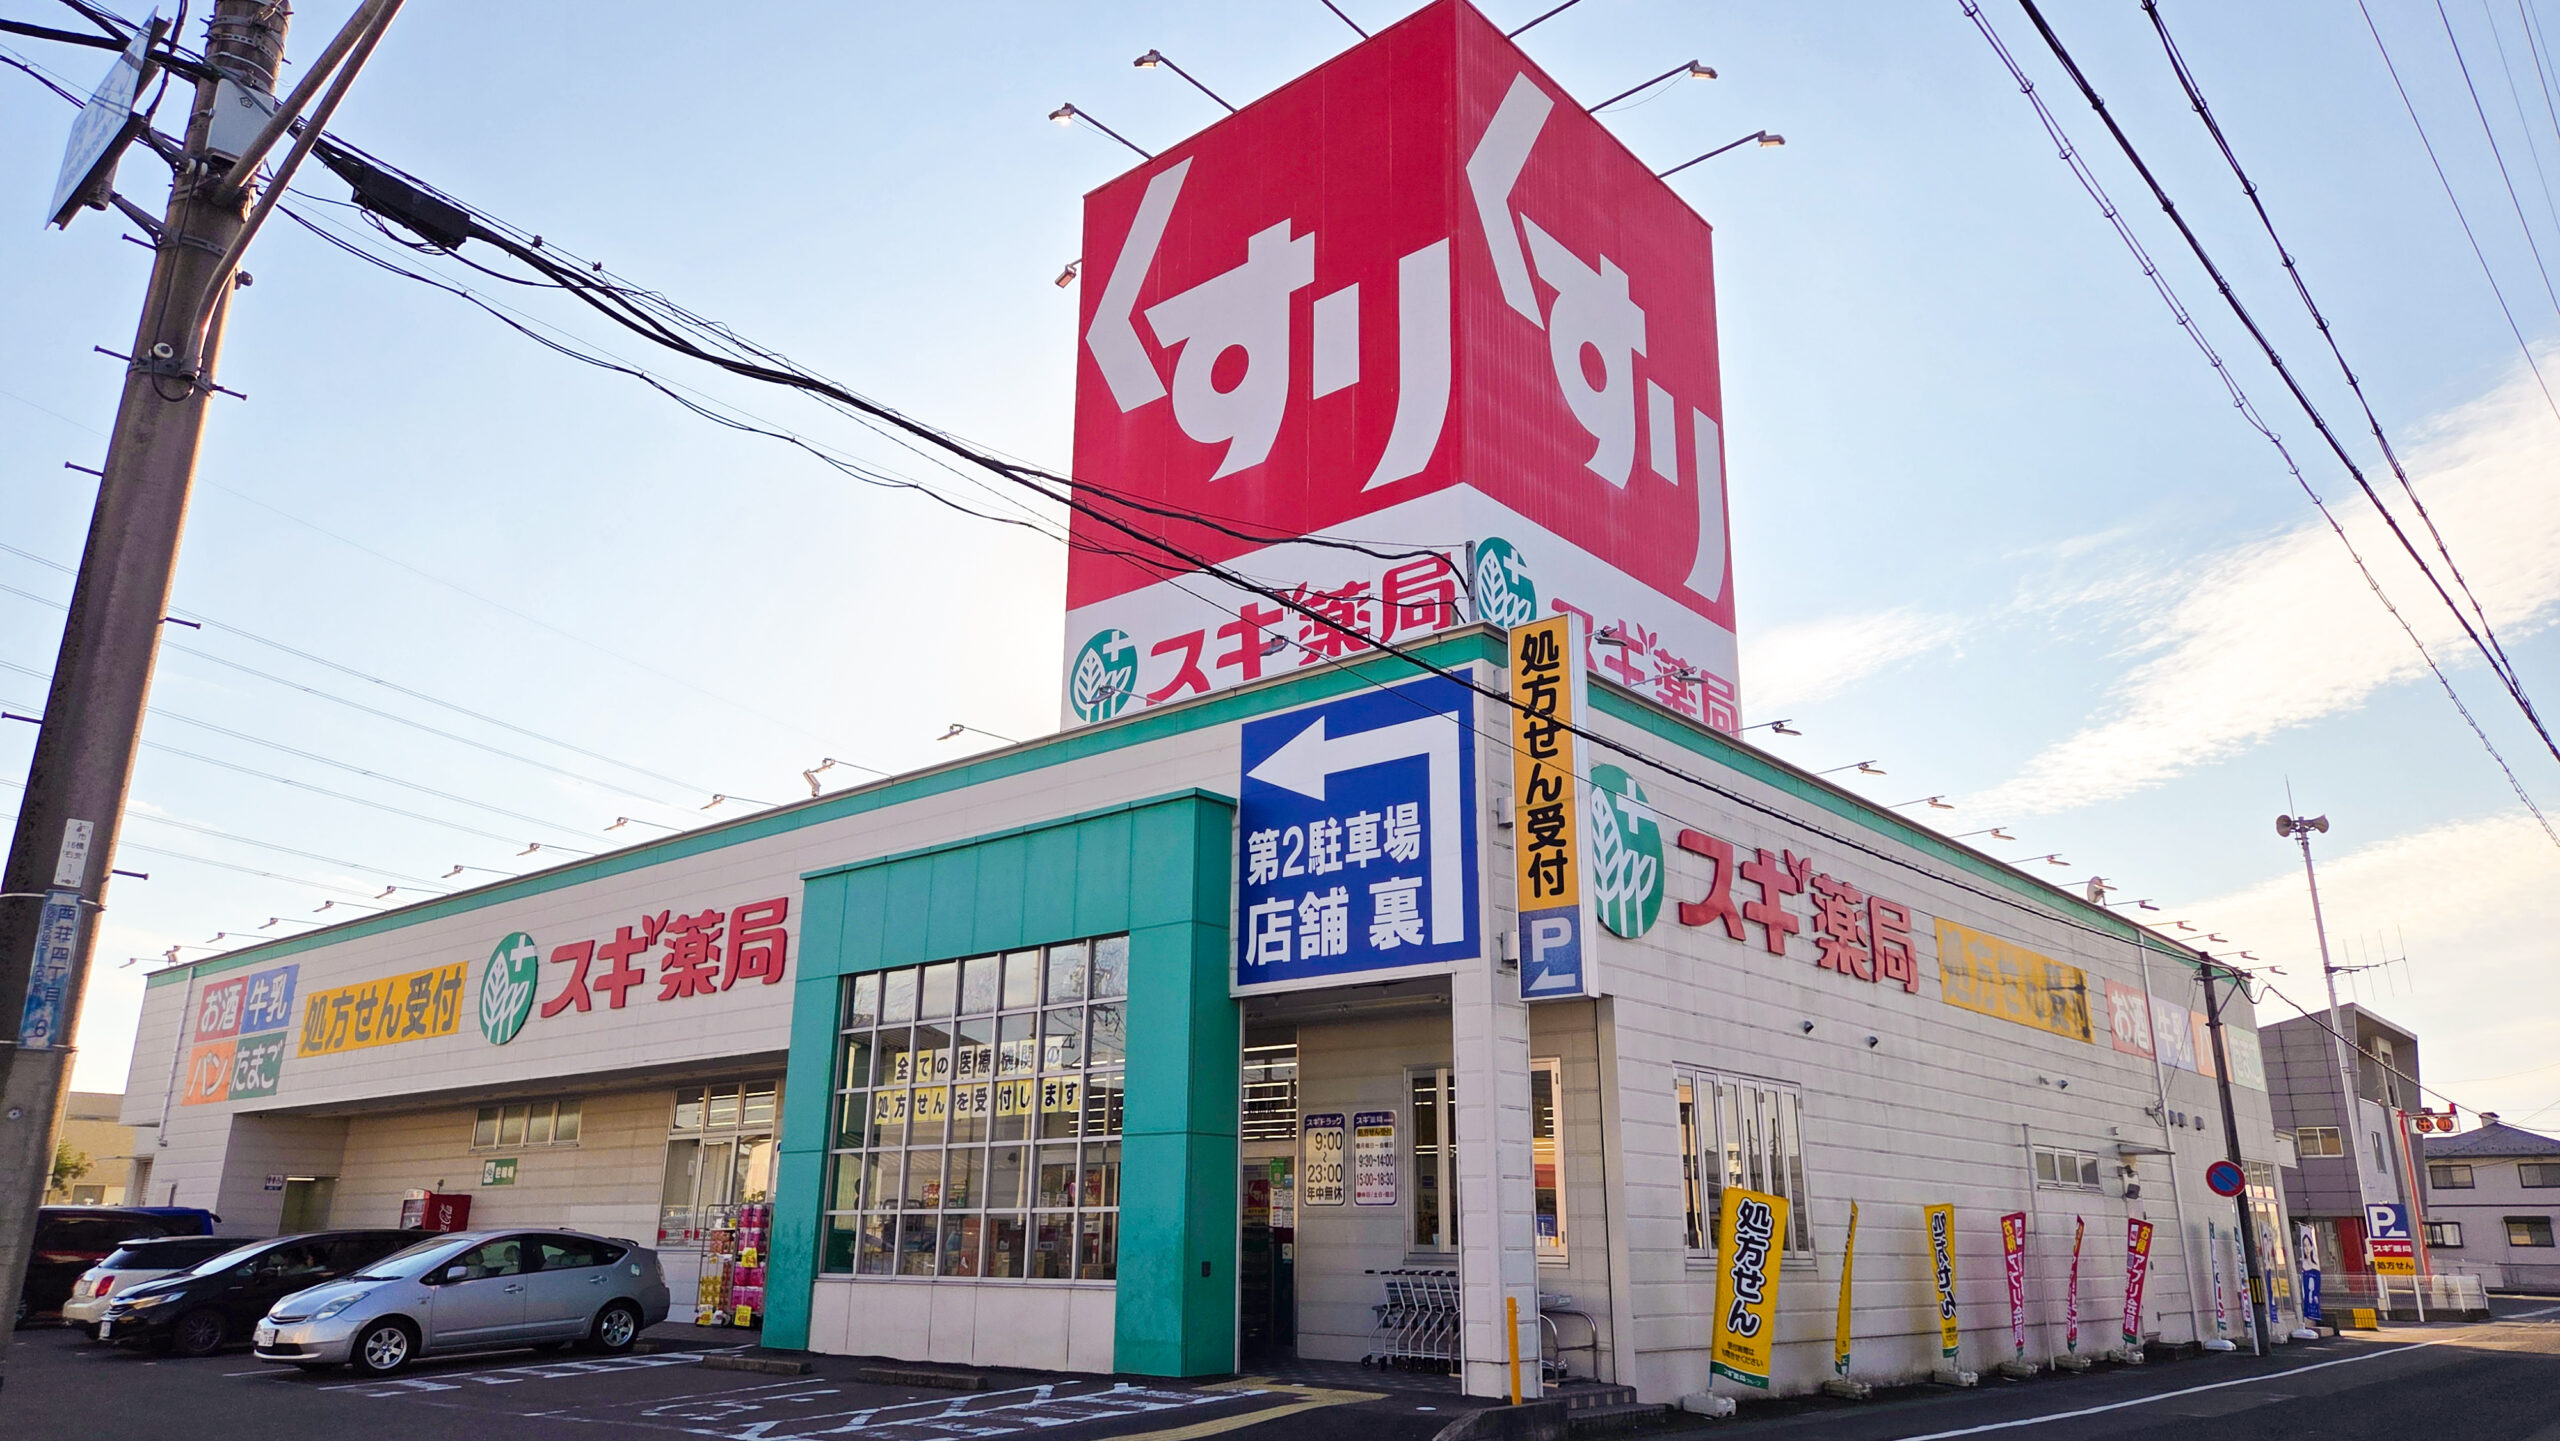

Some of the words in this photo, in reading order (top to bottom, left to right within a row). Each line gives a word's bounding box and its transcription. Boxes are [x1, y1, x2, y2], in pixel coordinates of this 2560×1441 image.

[1086, 156, 1452, 492] くすり
[1466, 71, 1725, 602] くすり
[1146, 552, 1456, 706] スギ薬局
[1520, 629, 1569, 898] 処方せん受付
[1247, 801, 1421, 886] 第2駐車場
[1245, 884, 1349, 967] 店舗
[1369, 877, 1426, 951] 裏
[1678, 828, 1919, 994] スギ薬局
[541, 897, 789, 1018] スギ薬局
[1531, 917, 1572, 963] P
[200, 983, 243, 1033] お酒
[248, 972, 288, 1025] 牛乳
[301, 966, 462, 1051] 処方せん受付
[2111, 989, 2151, 1051] お酒
[2156, 1005, 2192, 1064] 牛乳
[188, 1053, 229, 1097] パン
[231, 1037, 283, 1091] たまご
[876, 1081, 1078, 1120] 処方せんを受付します
[1307, 1116, 1343, 1126] スギドラッグ
[1315, 1131, 1342, 1151] 9:00
[1307, 1163, 1343, 1183] 23:00
[1307, 1185, 1343, 1200] 年中無休
[2368, 1206, 2396, 1237] P
[2373, 1244, 2412, 1253] スギ薬局
[1727, 1197, 1774, 1337] 処方せん
[2125, 1253, 2146, 1332] アプリ会員
[2376, 1261, 2414, 1270] 処方せん
